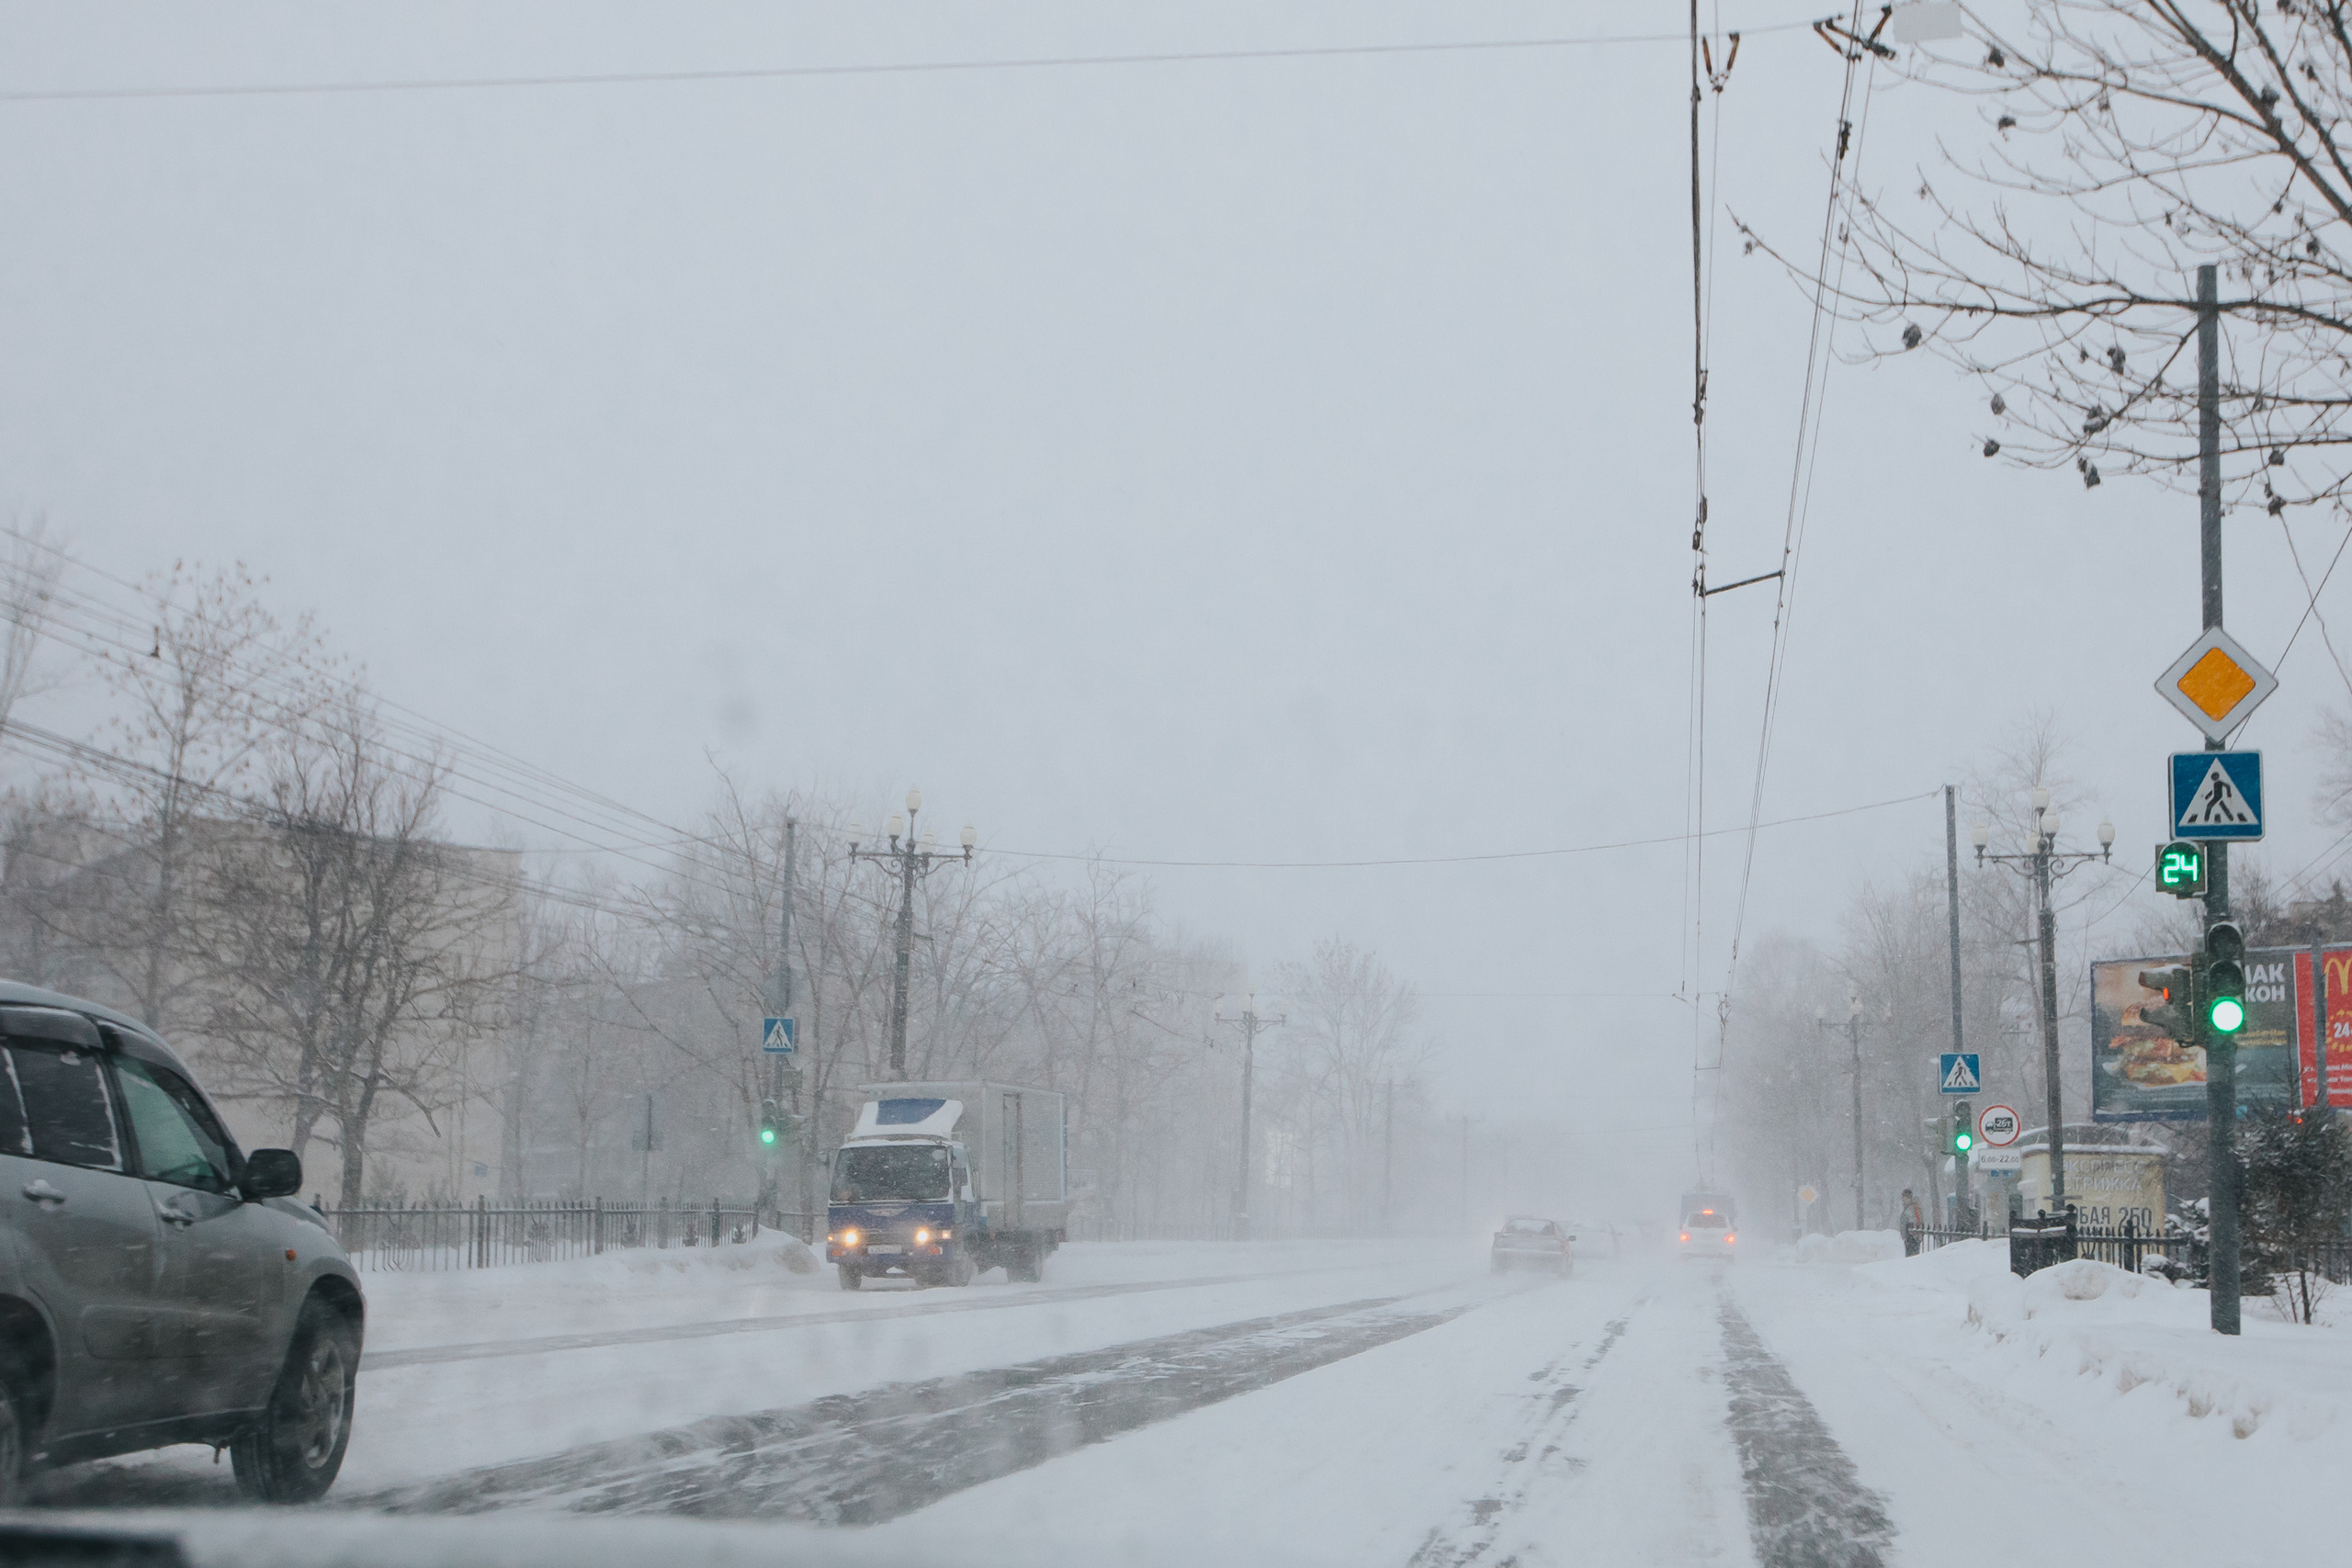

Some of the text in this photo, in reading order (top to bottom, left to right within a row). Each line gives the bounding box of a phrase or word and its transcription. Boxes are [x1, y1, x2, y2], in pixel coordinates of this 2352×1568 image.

[2164, 853, 2198, 882] 24
[2245, 984, 2286, 1003] КОН
[2075, 1205, 2111, 1224] БАЯ
